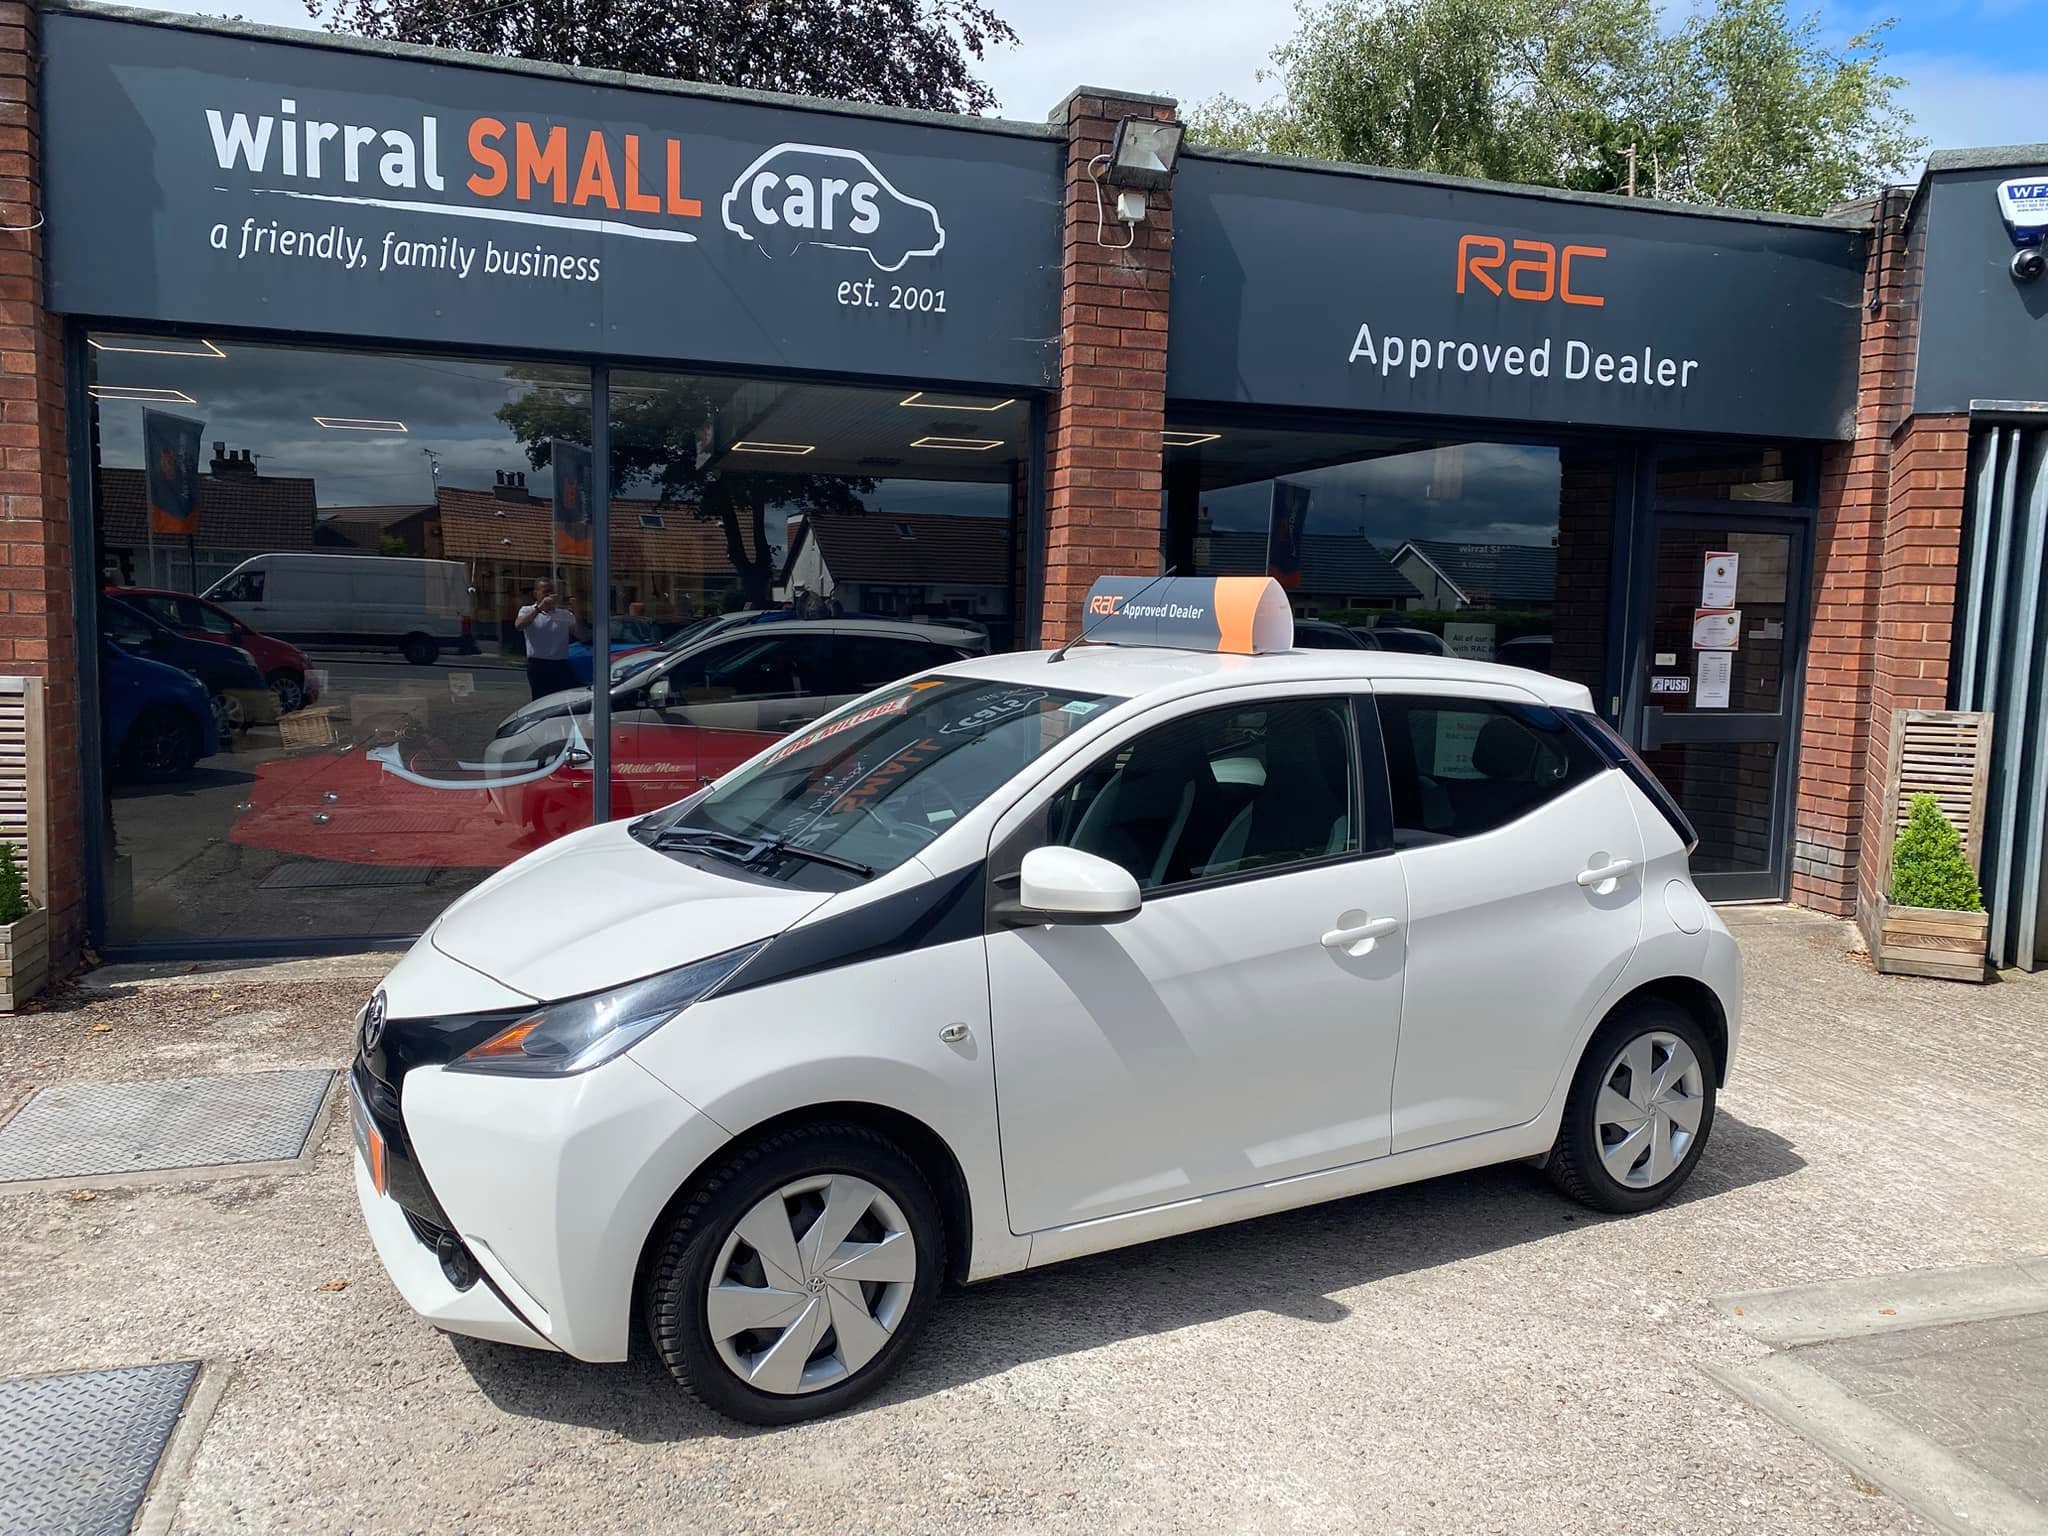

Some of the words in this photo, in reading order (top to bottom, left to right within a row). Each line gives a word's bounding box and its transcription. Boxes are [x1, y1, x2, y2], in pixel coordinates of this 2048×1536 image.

[205, 98, 444, 191] wirral
[466, 117, 702, 216] SMALL
[751, 171, 880, 234] cars
[2013, 186, 2048, 198] WF
[209, 222, 228, 249] a
[238, 218, 368, 269] friendly,
[379, 232, 476, 279] family
[484, 242, 600, 281] business
[837, 278, 879, 307] est.
[889, 285, 947, 312] 2001
[1348, 323, 1551, 378] Approved
[1565, 340, 1699, 387] Dealer
[1122, 603, 1168, 619] Approved
[1169, 604, 1204, 619] Dealer
[1664, 679, 1687, 690] PUSH
[768, 735, 815, 764] LOW
